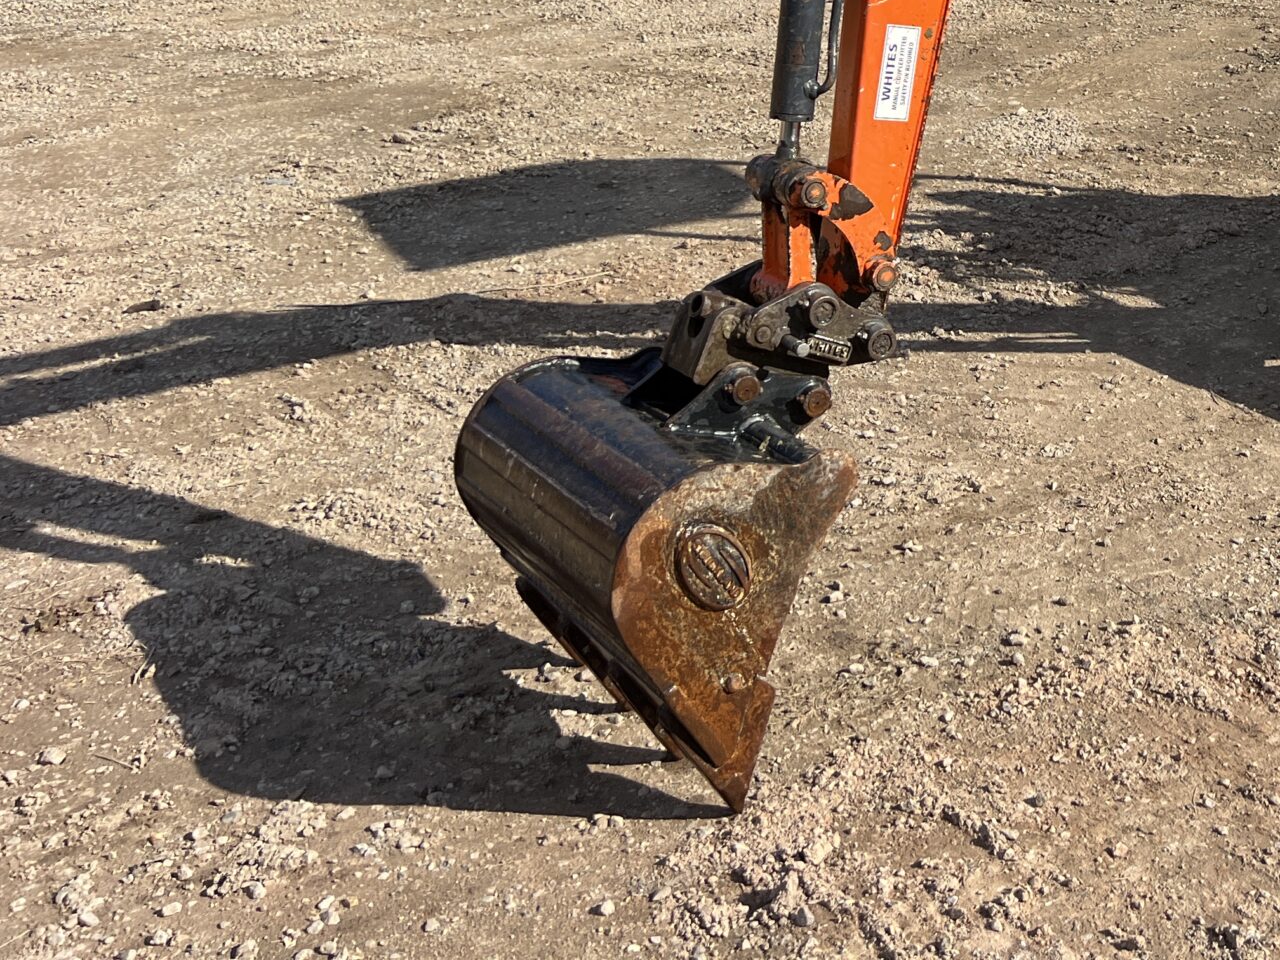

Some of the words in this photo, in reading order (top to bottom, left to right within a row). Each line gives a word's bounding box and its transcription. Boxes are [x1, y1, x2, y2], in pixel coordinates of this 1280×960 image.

[881, 43, 898, 101] WHITES
[895, 58, 904, 85] COUPLER
[900, 84, 908, 106] SAFETY
[905, 42, 914, 72] REQUIRED
[891, 86, 900, 111] MANUAL
